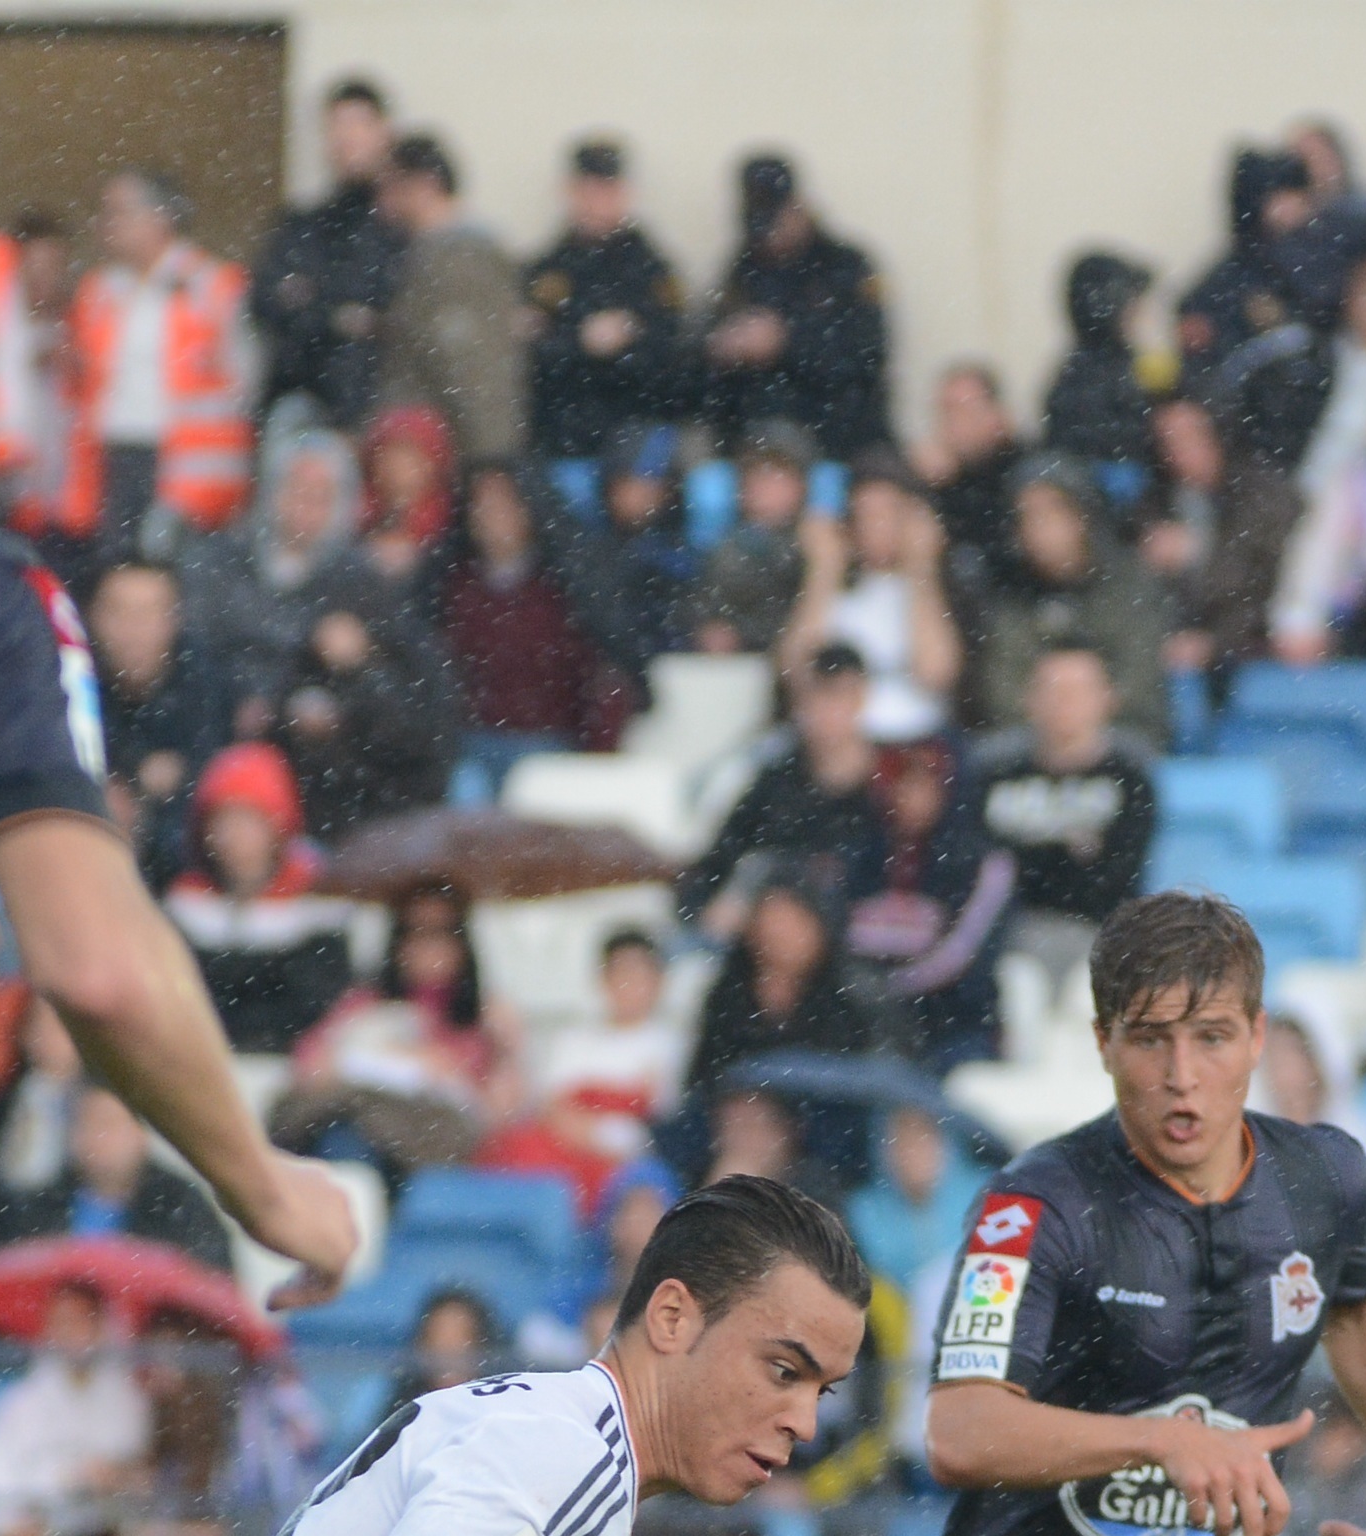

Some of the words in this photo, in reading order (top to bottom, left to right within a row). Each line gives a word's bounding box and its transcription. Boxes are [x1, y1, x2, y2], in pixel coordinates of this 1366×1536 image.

[952, 1312, 1003, 1339] LFP
[944, 1351, 999, 1371] BBVA
[1099, 1481, 1240, 1531] Gali
